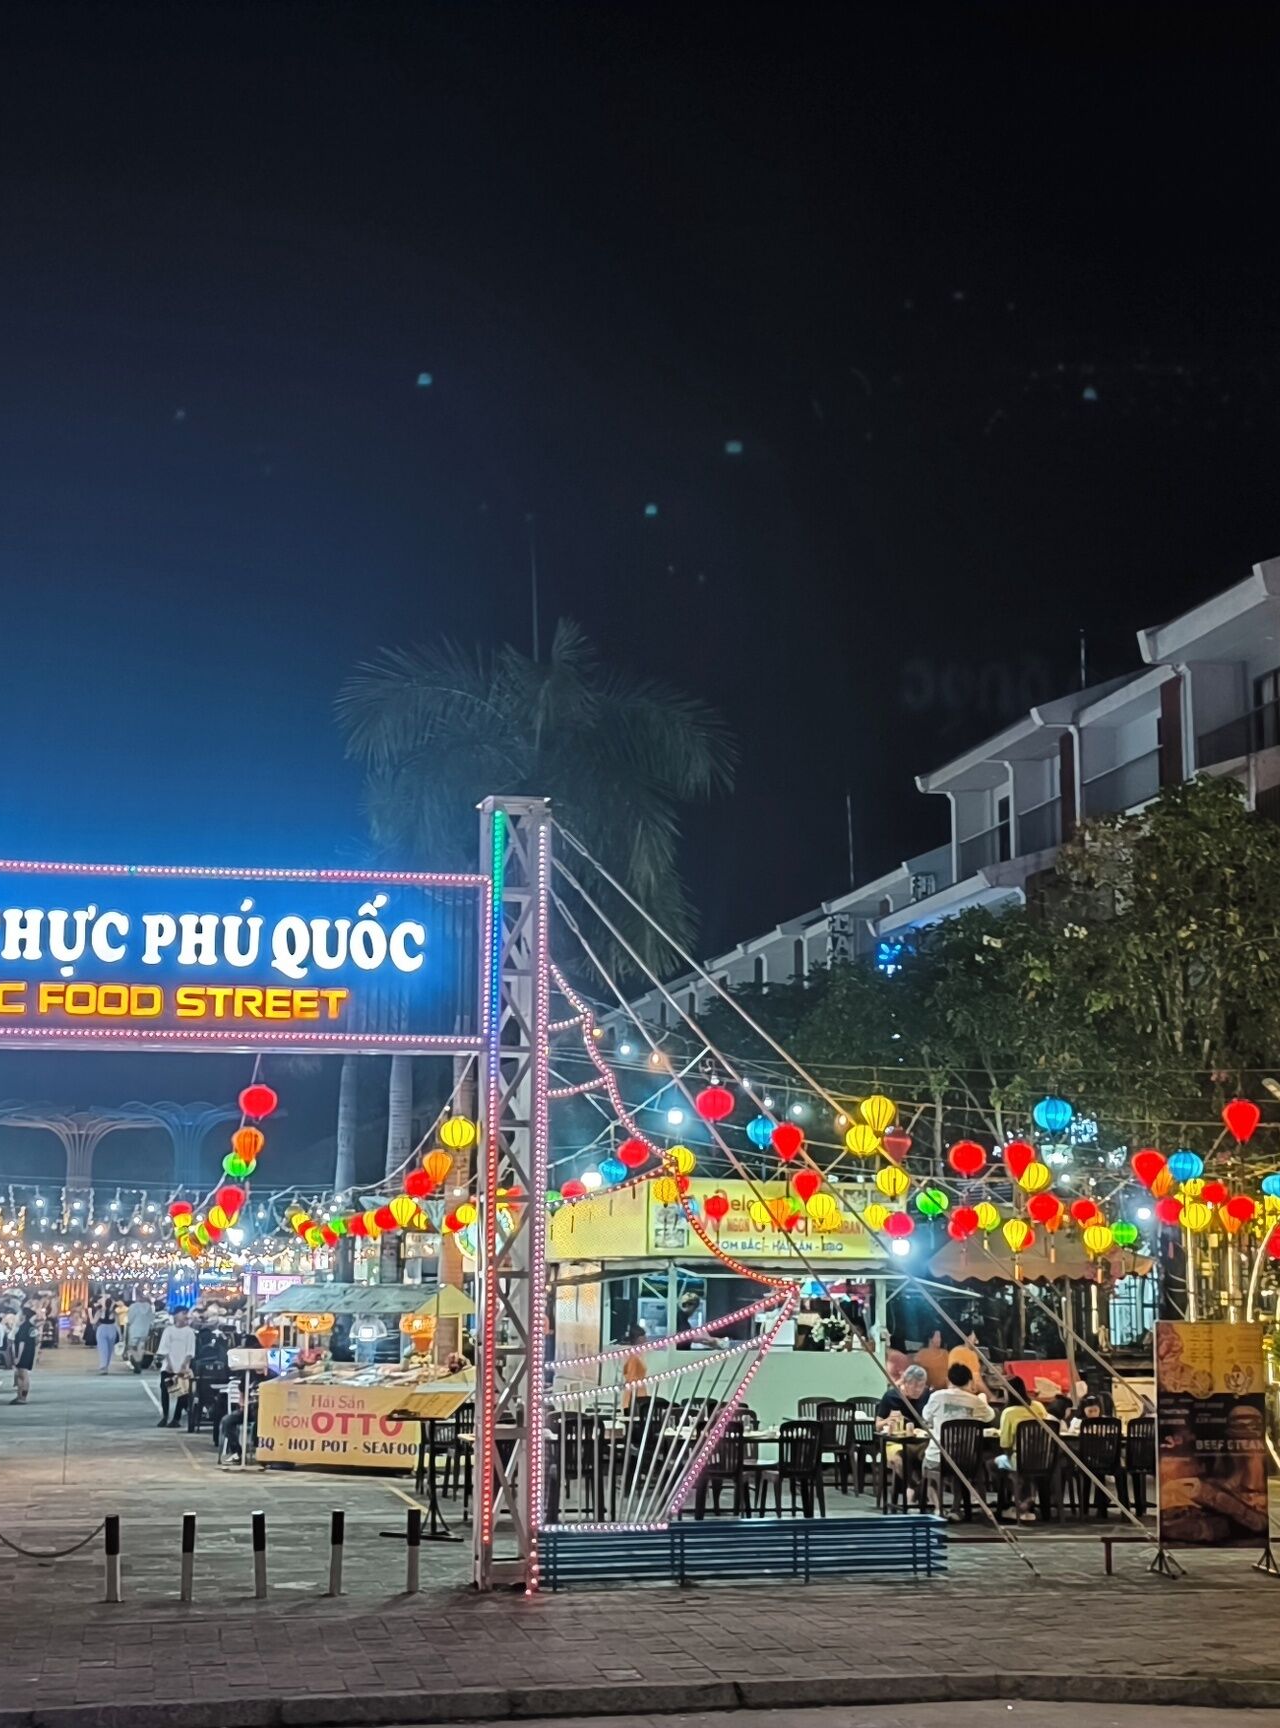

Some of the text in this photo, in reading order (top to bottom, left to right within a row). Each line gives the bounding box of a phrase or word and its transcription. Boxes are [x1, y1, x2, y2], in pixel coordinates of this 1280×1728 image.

[141, 898, 265, 966] PHÚ
[271, 894, 426, 979] QUỐC
[37, 982, 164, 1016] FOOD
[175, 985, 349, 1020] STREET
[273, 1412, 404, 1437] NGON OTTO
[288, 1438, 316, 1451] HOT
[321, 1440, 349, 1453] POT
[363, 1442, 419, 1456] SEAFOO
